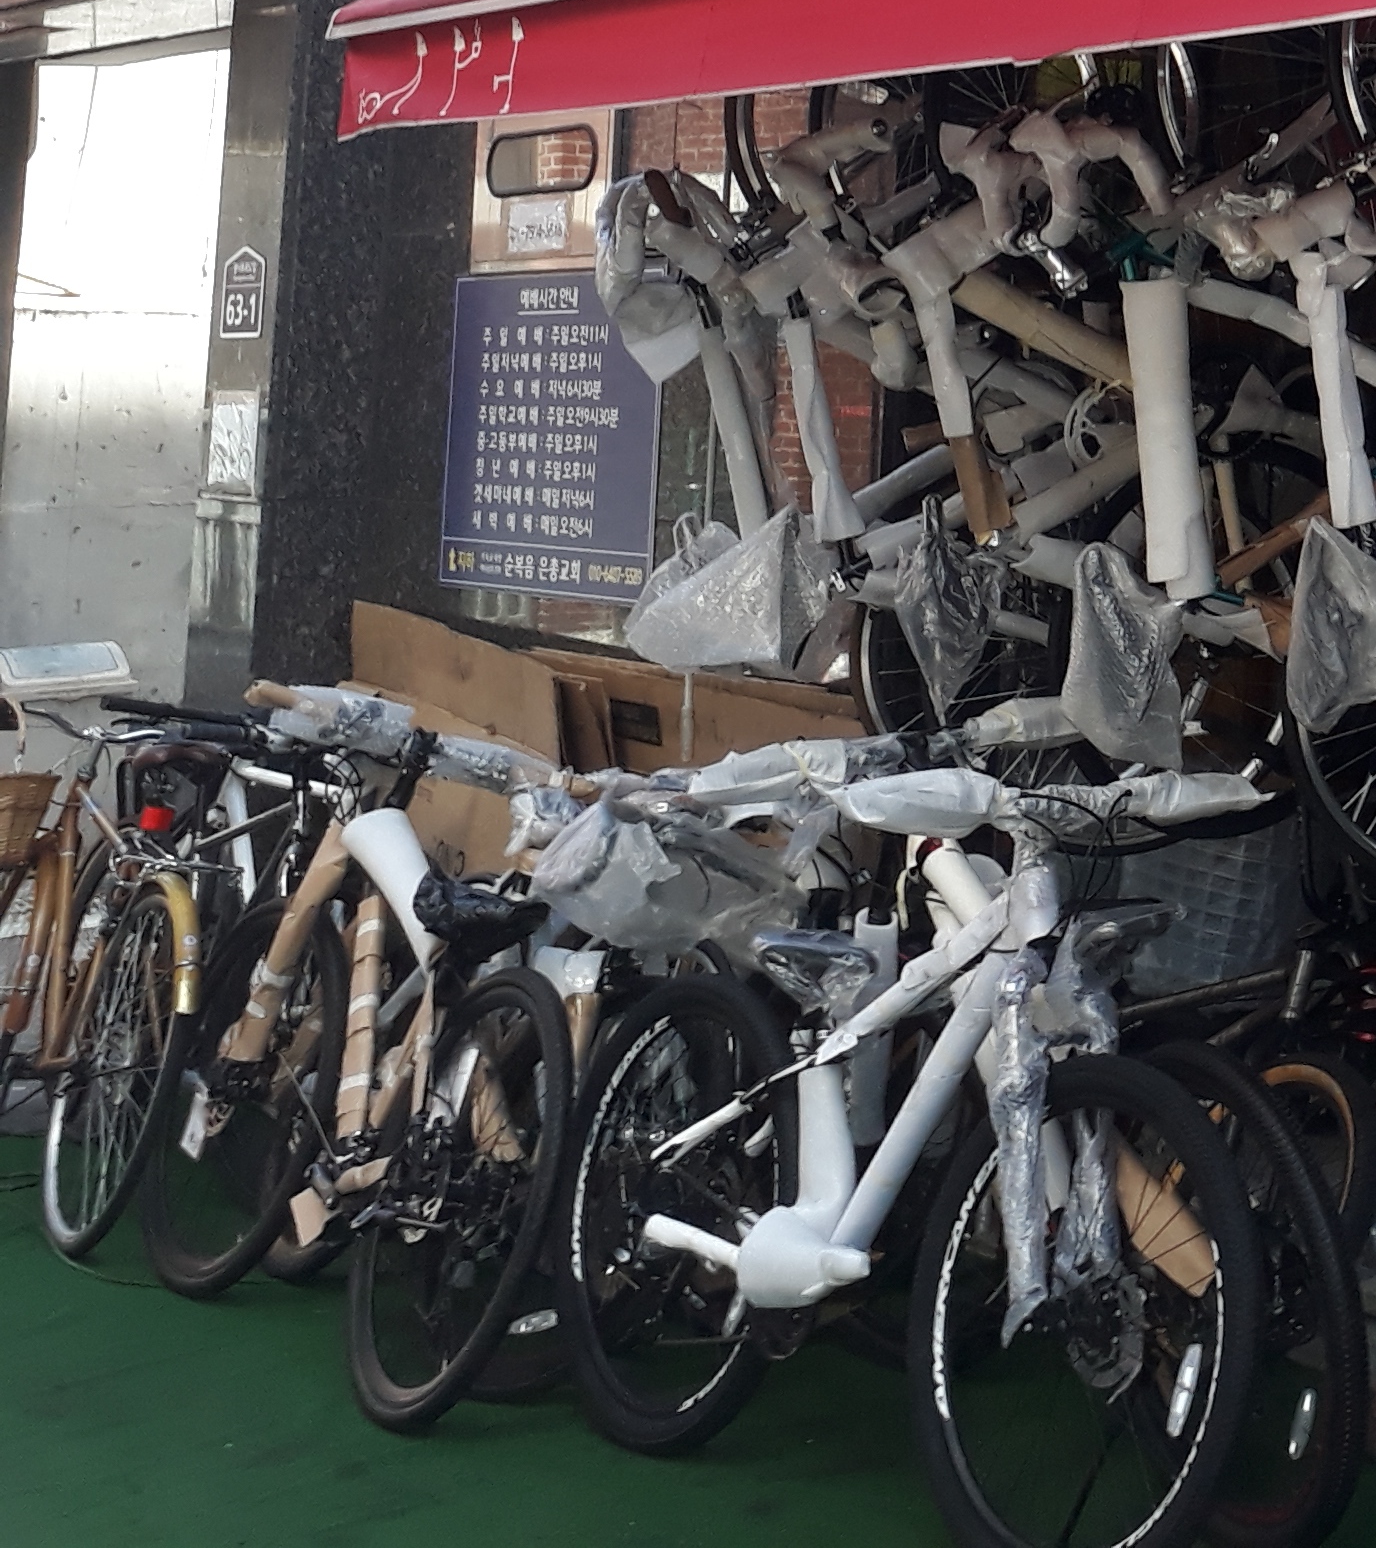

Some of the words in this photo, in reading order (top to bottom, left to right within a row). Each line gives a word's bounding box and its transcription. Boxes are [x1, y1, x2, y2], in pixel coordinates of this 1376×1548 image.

[226, 293, 256, 326] 63-1
[520, 287, 557, 309] 예배시간
[560, 286, 579, 308] 안내
[504, 553, 535, 579] 순복음
[538, 556, 581, 584] 은총교회
